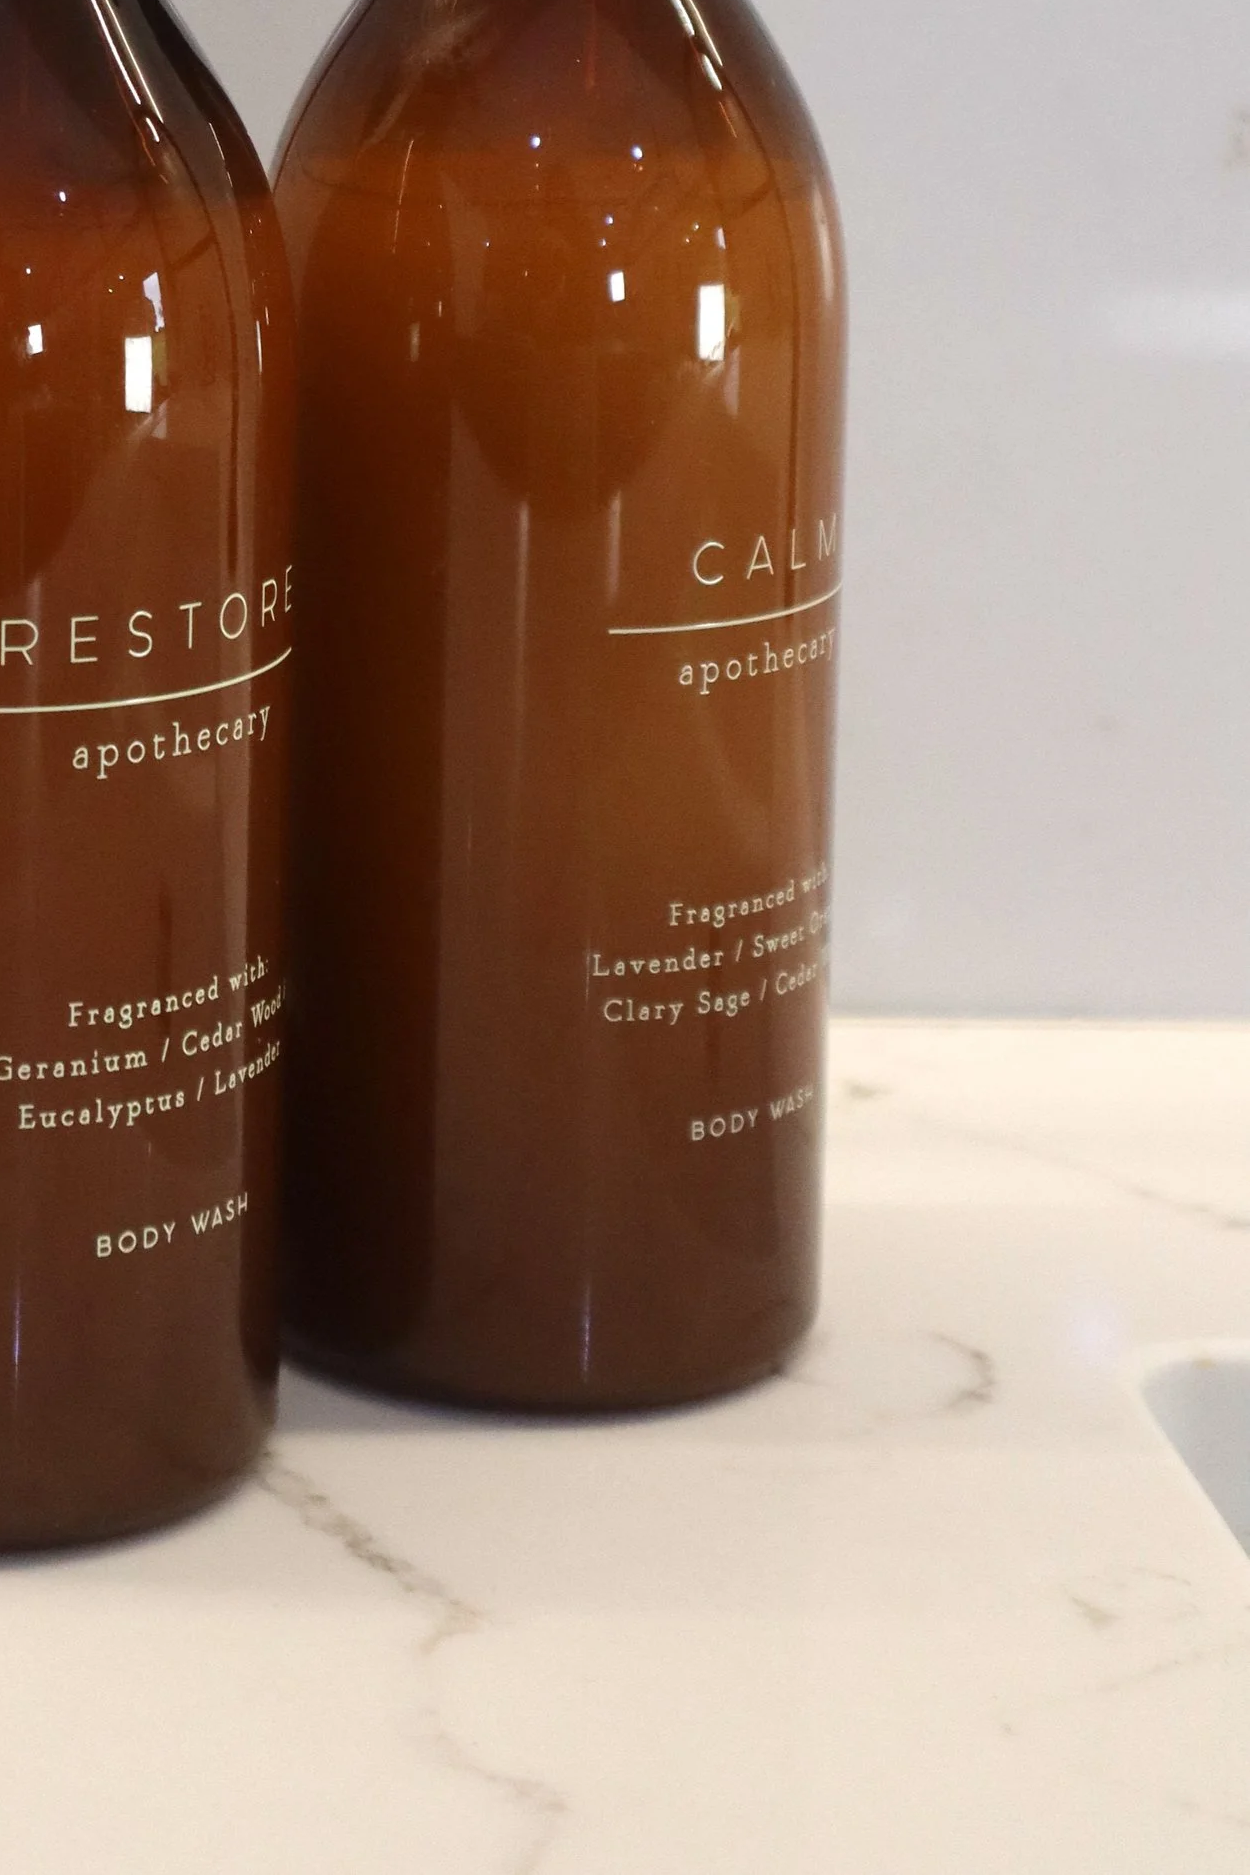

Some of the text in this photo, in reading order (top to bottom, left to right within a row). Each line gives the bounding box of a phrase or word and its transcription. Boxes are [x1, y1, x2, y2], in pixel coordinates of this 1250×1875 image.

[692, 512, 837, 585] CALM
[0, 564, 293, 666] RESTORE
[678, 628, 835, 695] apothecary
[72, 705, 271, 779] apothecary
[668, 878, 795, 928] Fragranced
[592, 948, 724, 976] Lavender
[752, 926, 805, 959] Sweet
[68, 955, 269, 1029] Fragranced with:
[161, 1038, 170, 1063] /
[181, 1019, 243, 1057] Cedar
[251, 984, 282, 1029] Wood
[603, 999, 684, 1025] Clary
[698, 991, 751, 1017] Sage
[775, 963, 818, 995] Cedar
[18, 1039, 281, 1130] Eucalyptus / Lavender
[691, 1108, 759, 1141] BODY
[96, 1191, 249, 1258] BODY WASH
